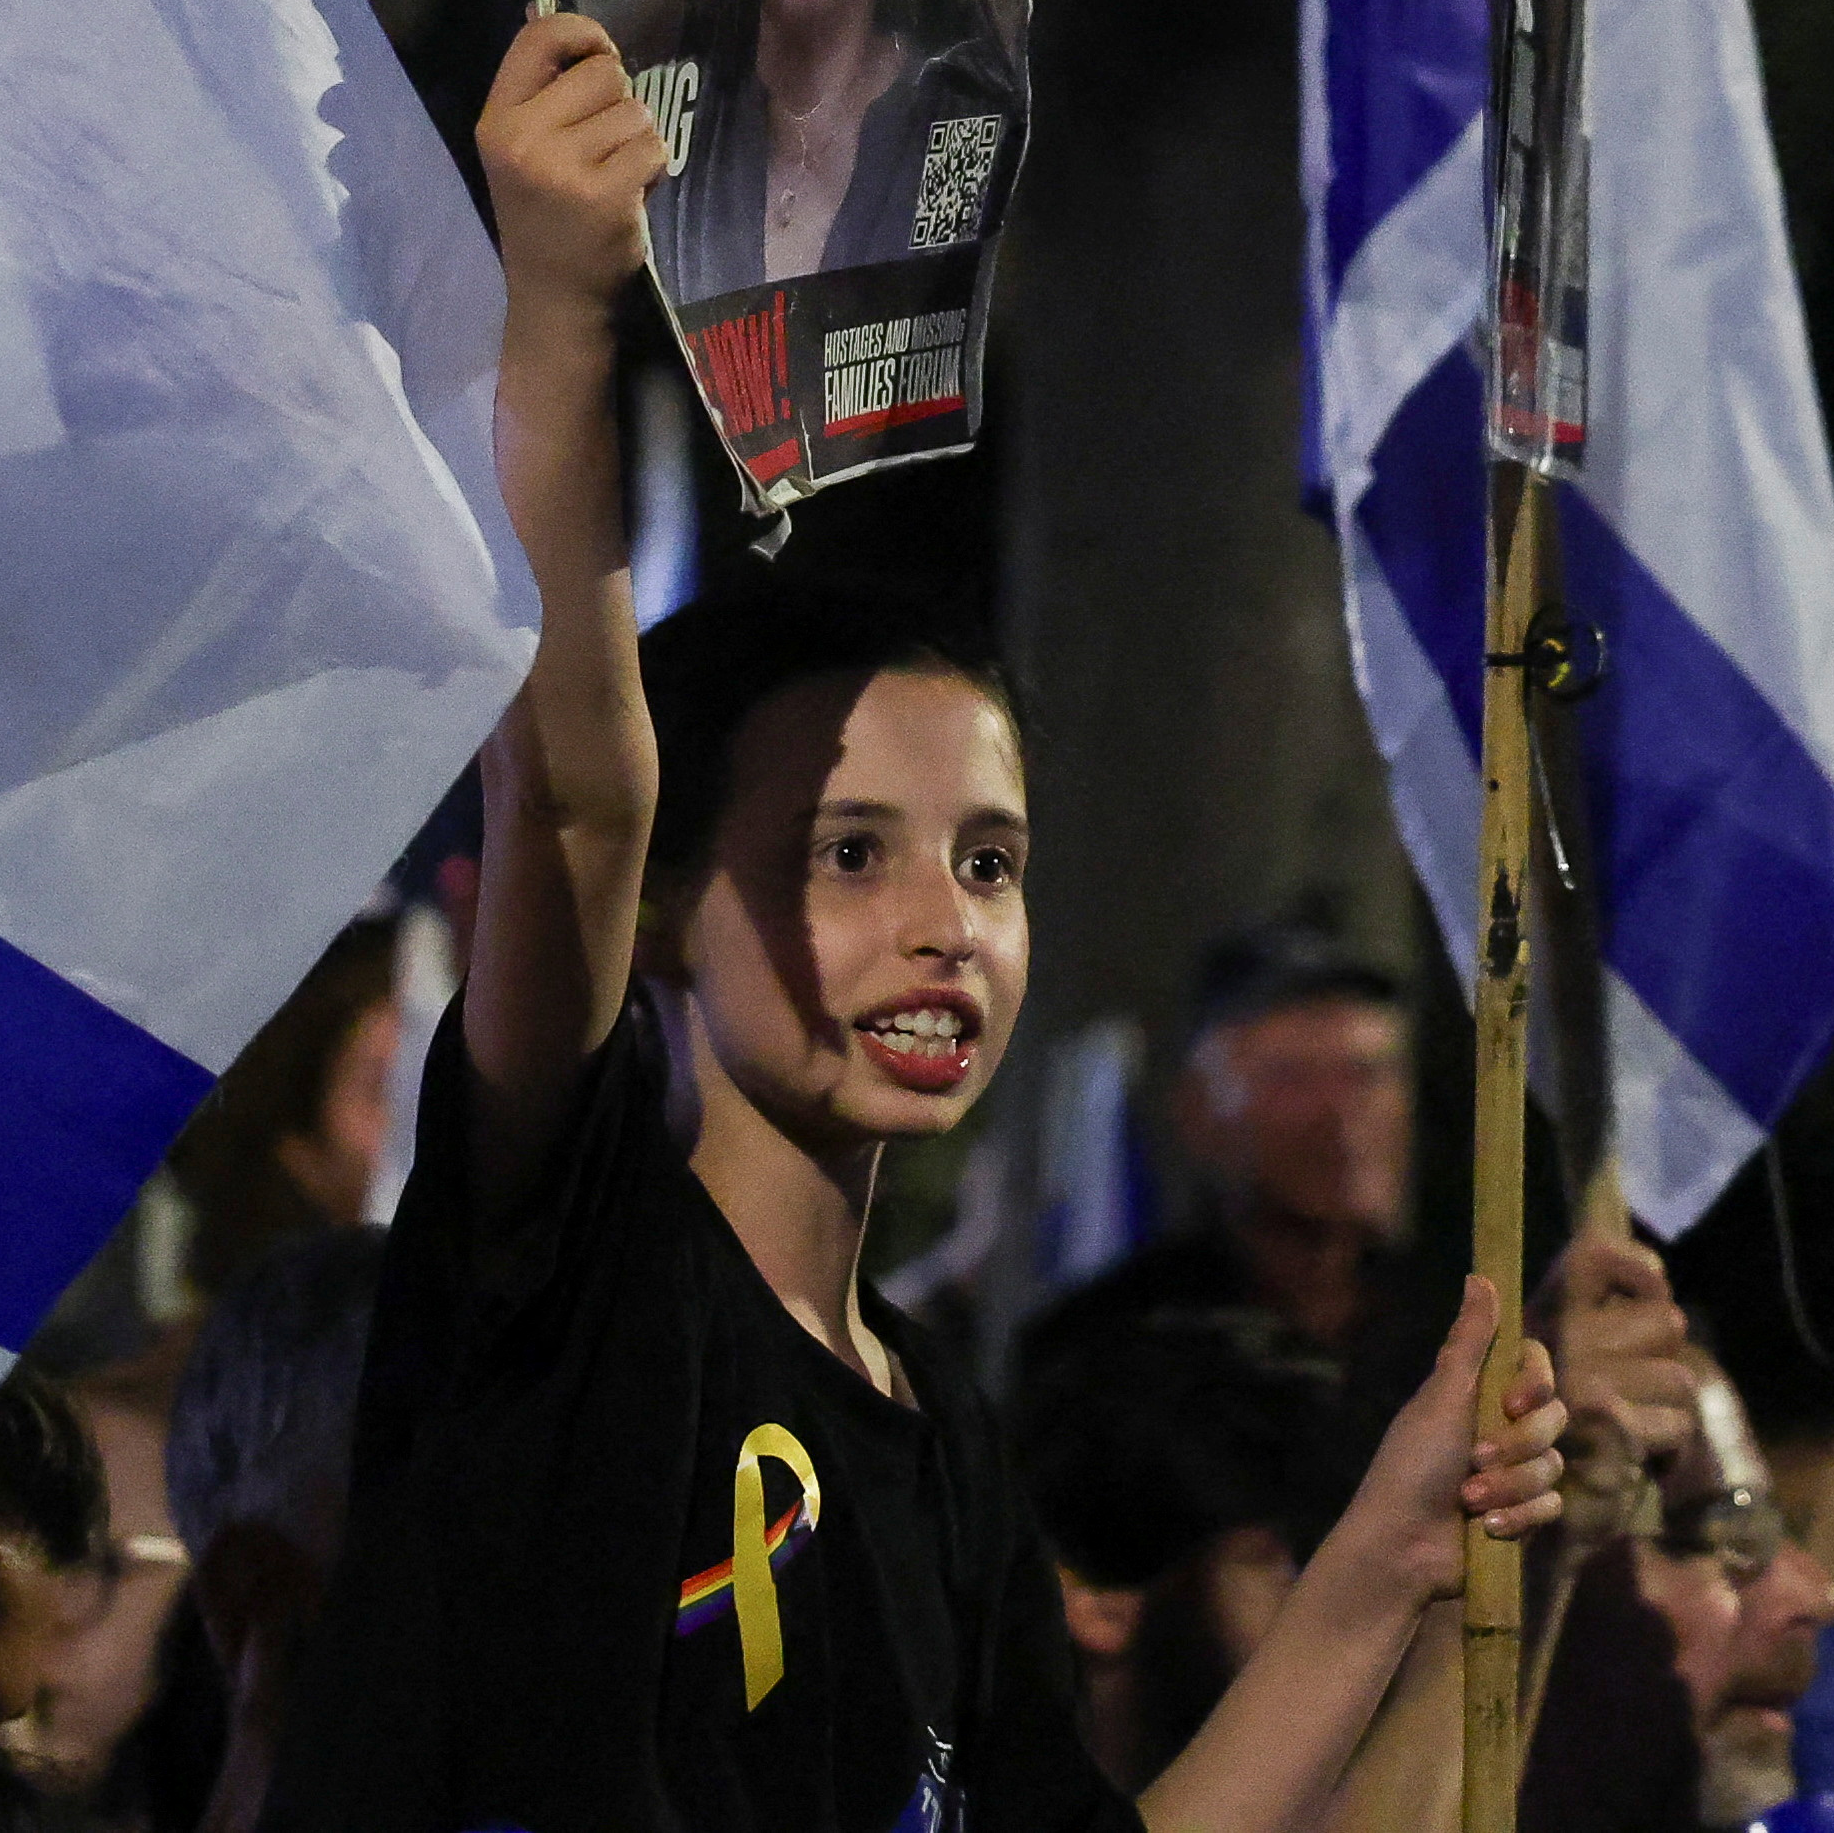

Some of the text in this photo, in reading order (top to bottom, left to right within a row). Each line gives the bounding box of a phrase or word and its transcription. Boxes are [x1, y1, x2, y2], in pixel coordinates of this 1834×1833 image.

[824, 308, 967, 369] HOSTAGES AND MISSING
[824, 344, 960, 425] FAMILIES FORUM
